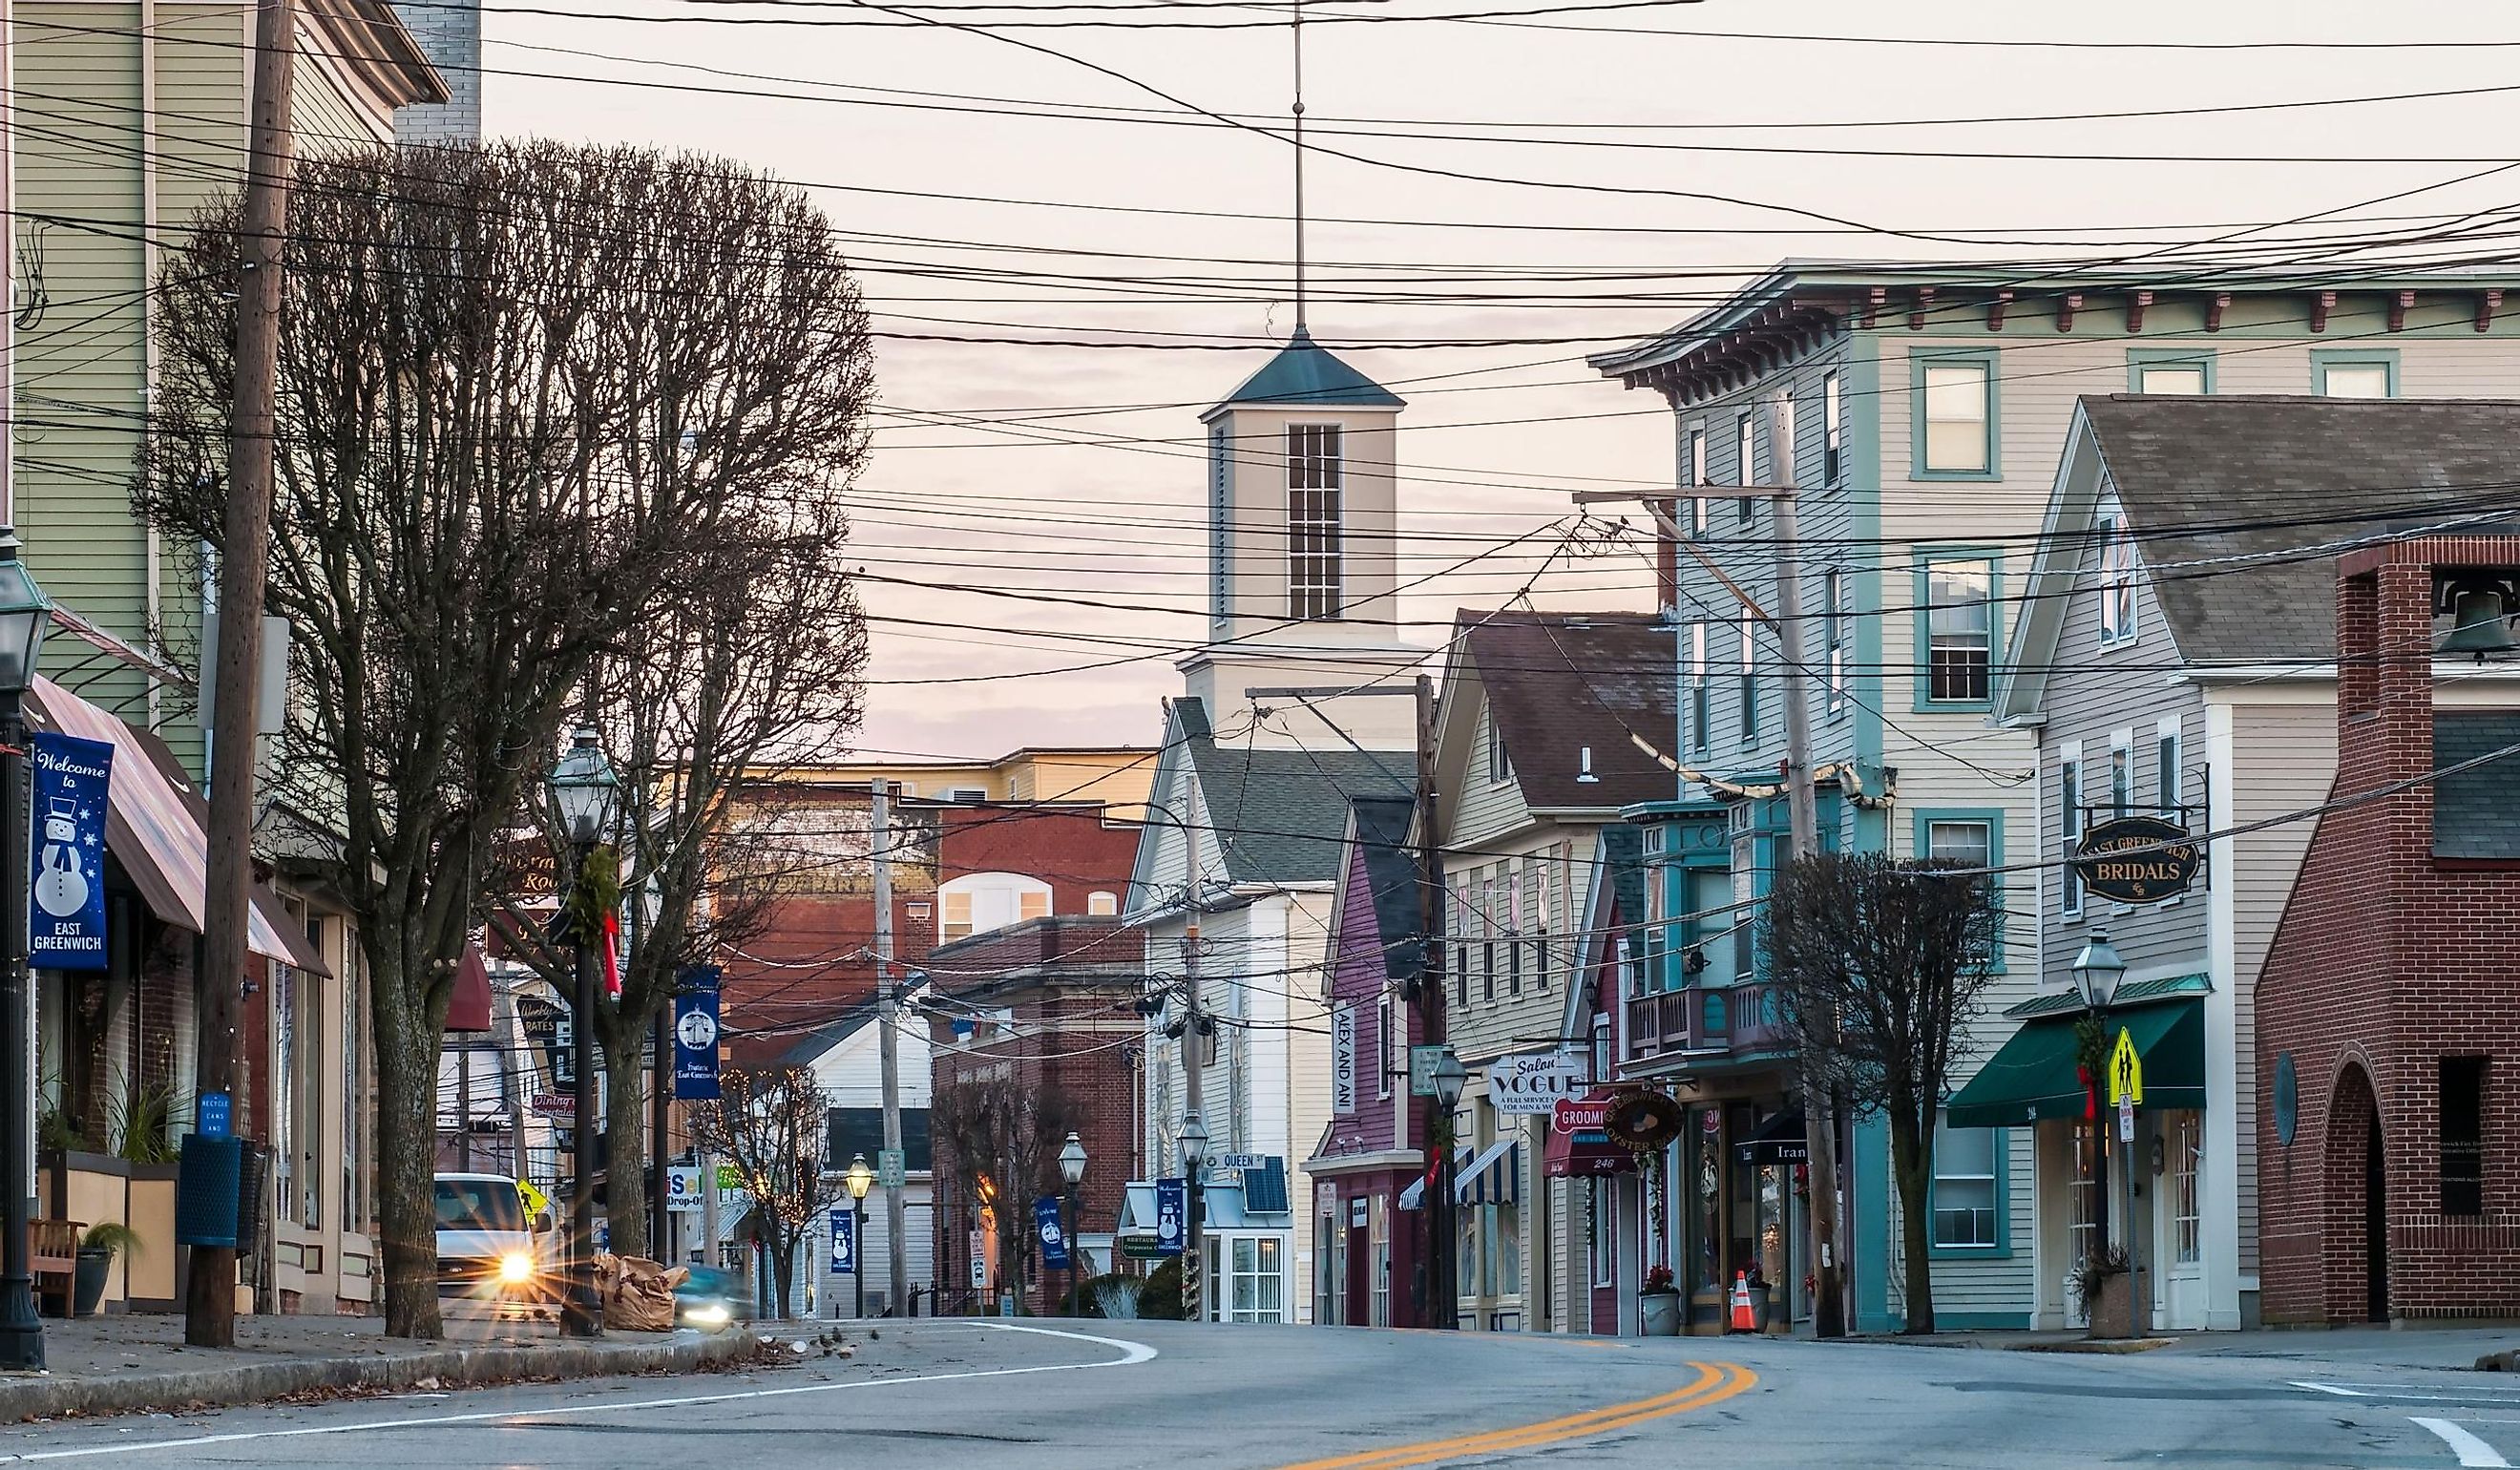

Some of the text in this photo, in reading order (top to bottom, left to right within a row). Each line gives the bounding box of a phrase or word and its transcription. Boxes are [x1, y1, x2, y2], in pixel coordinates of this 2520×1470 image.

[37, 752, 106, 778] Welcome
[62, 774, 77, 788] to
[2096, 863, 2180, 880] BRIDALS
[54, 922, 82, 935] EAST
[34, 935, 102, 951] GREENWICH
[525, 1021, 555, 1032] RATES
[1338, 1013, 1351, 1107] ALEX AND ANI
[1517, 1058, 1555, 1075] Salon
[1493, 1076, 1581, 1094] VOGUE
[535, 1096, 569, 1107] Dining
[1562, 1110, 1604, 1124] GROOMI
[1778, 1146, 1806, 1158] Iran
[1225, 1154, 1253, 1166] QUEEN
